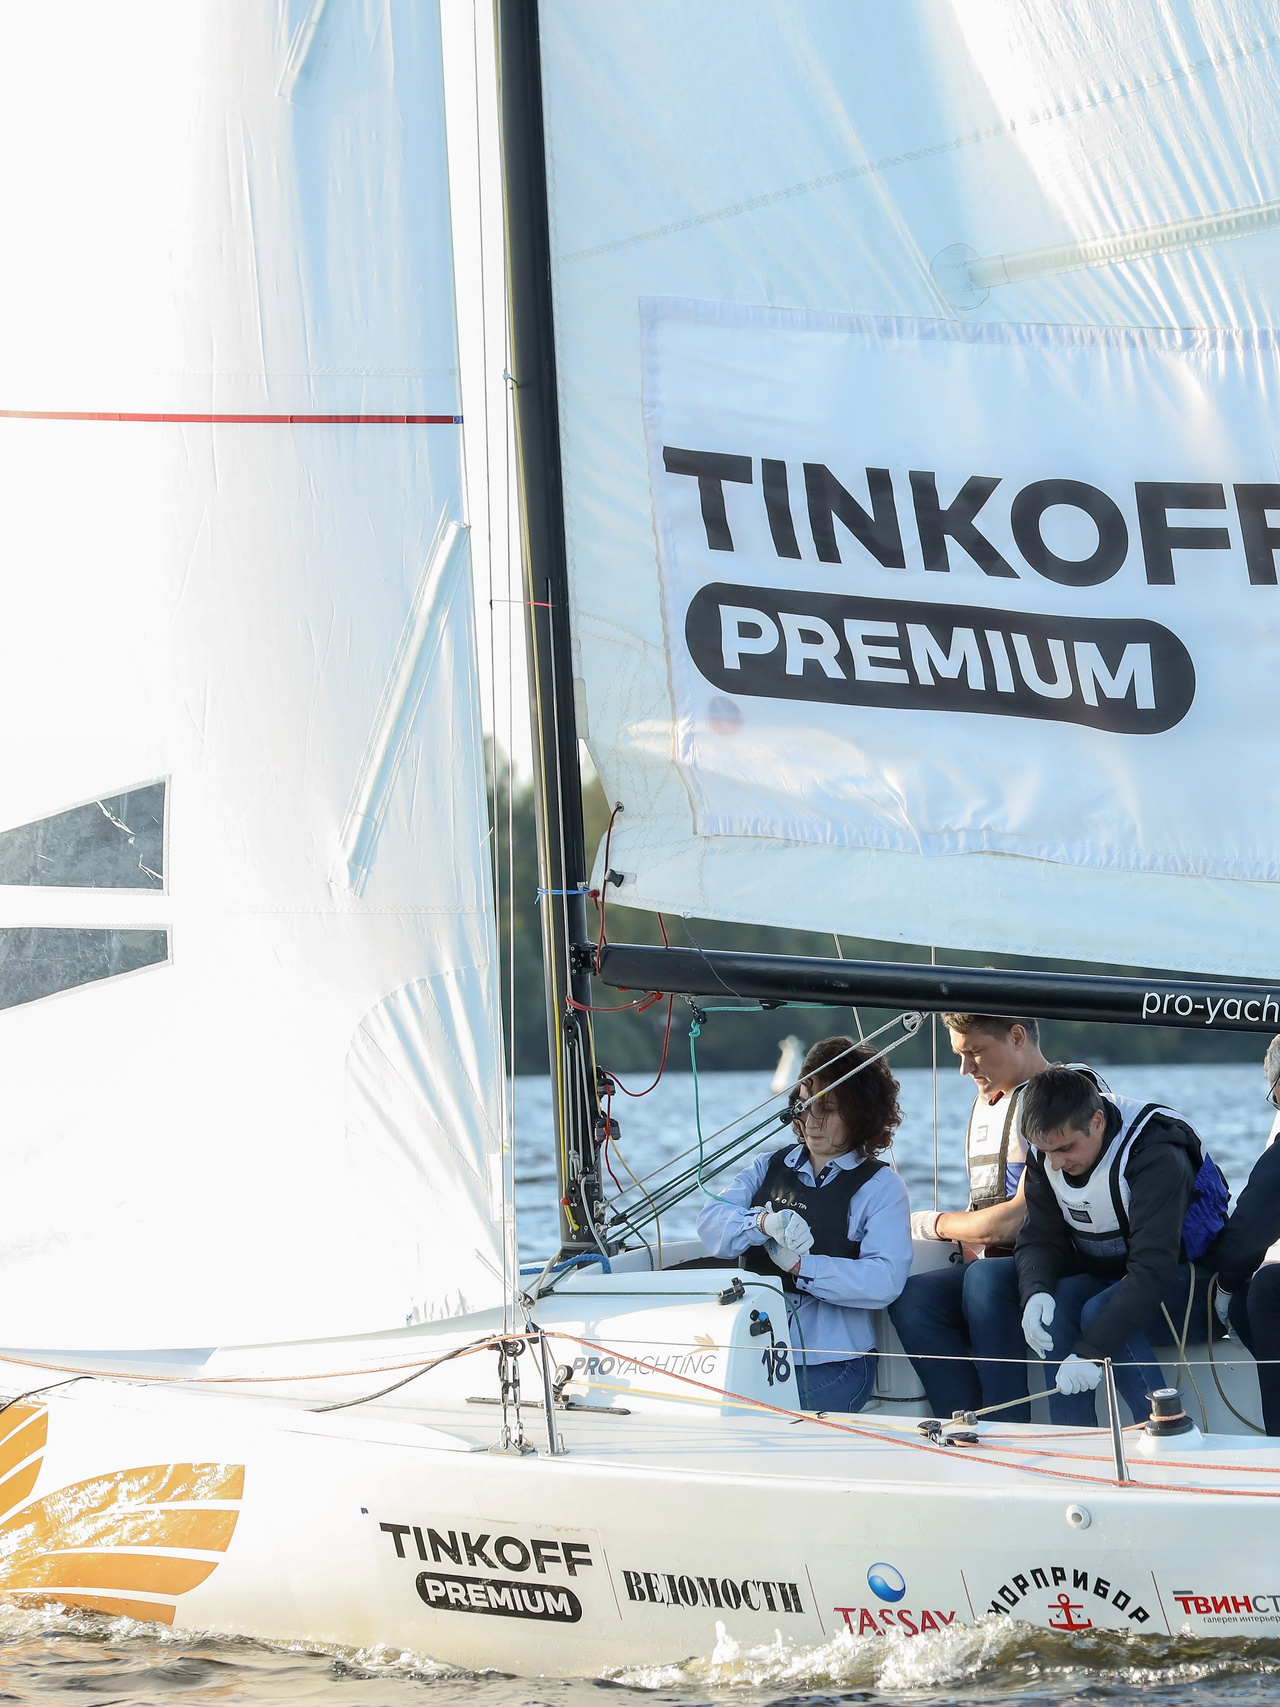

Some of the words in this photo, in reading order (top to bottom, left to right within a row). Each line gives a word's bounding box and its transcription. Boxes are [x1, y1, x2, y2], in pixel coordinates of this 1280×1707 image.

[717, 604, 1157, 710] PREMIUM
[571, 1353, 717, 1376] PROYACHTING
[761, 1340, 791, 1387] 18
[378, 1521, 594, 1577] TINKOFF
[424, 1578, 573, 1617] PREMIUM
[620, 1569, 806, 1615] ВЕДОМОСТИ
[987, 1565, 1151, 1624] МОРПРИБОР
[1203, 1616, 1238, 1625] галерея
